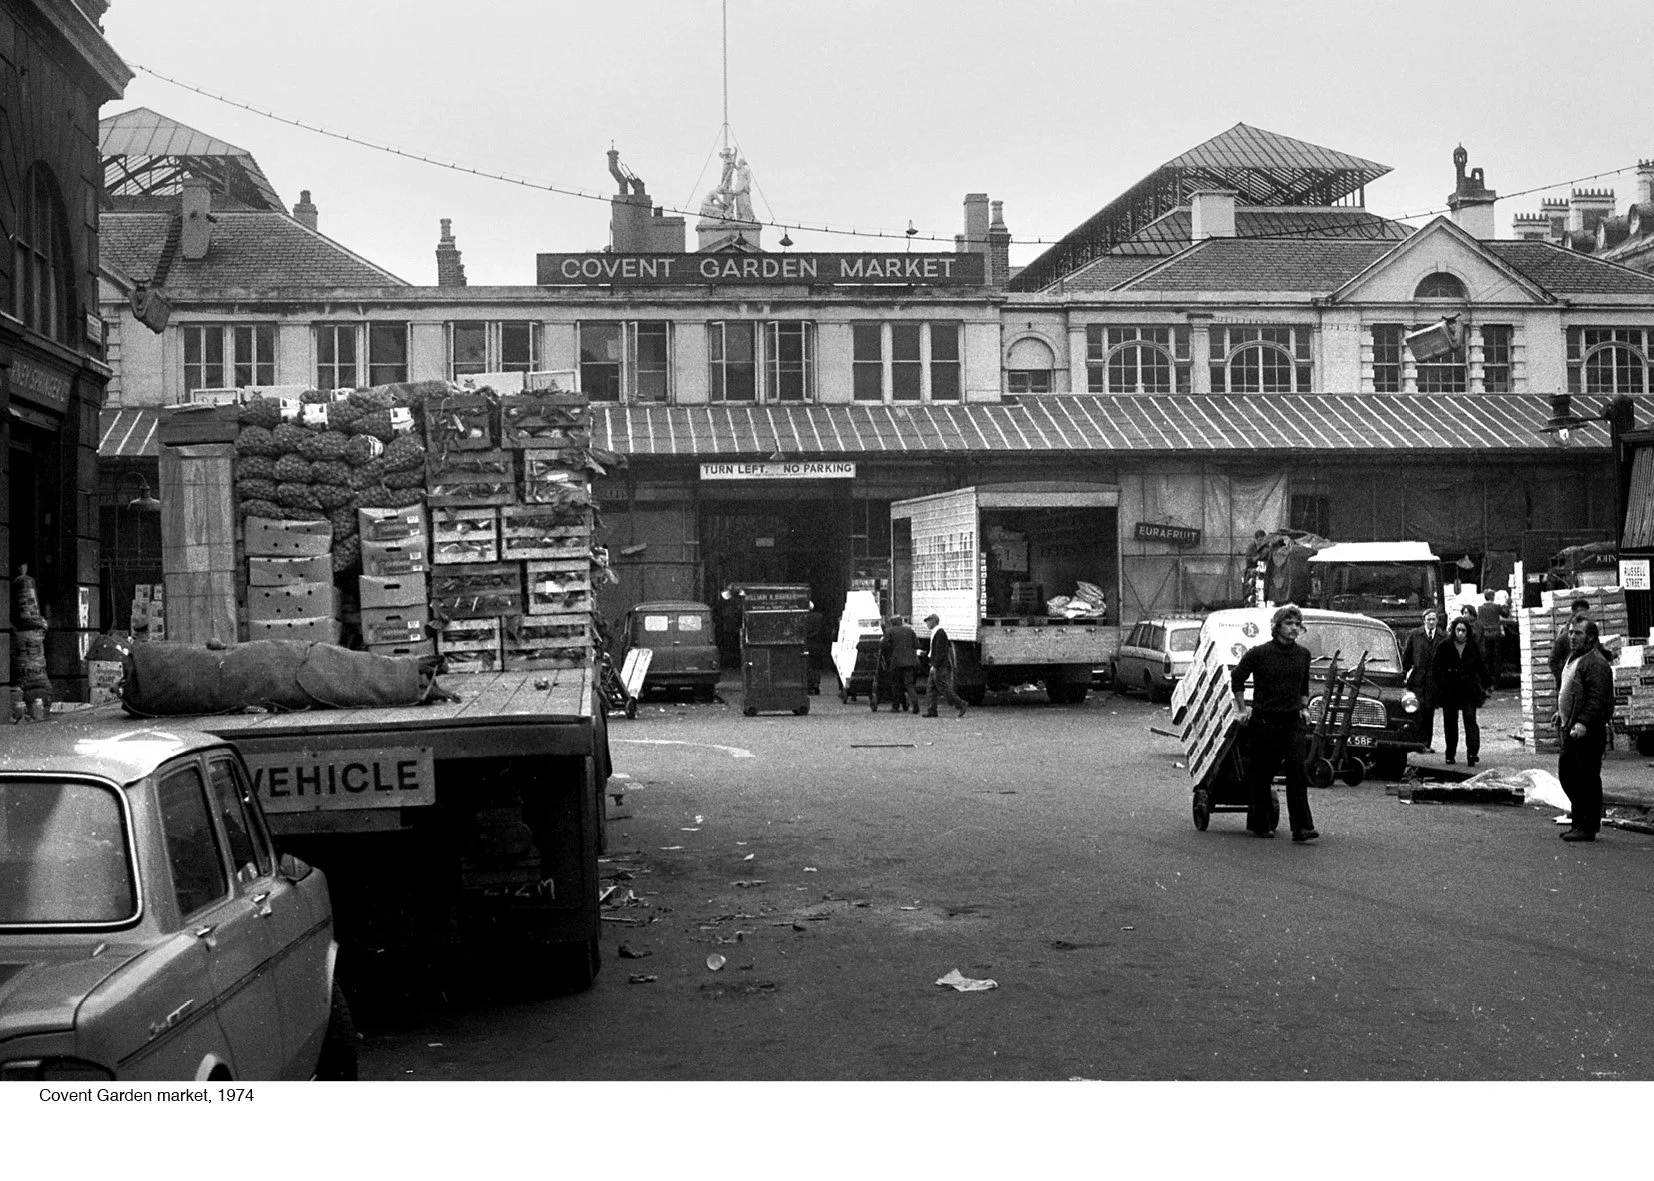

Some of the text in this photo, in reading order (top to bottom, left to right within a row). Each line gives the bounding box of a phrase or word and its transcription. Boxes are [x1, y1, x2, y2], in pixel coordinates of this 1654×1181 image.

[561, 257, 957, 280] COVENT GARDEN MARKET
[704, 463, 852, 475] TURN LEFT. NO PARKING
[1139, 525, 1197, 541] EURAFRUIT
[1624, 566, 1646, 577] RUSSELL
[1625, 578, 1643, 588] STREET
